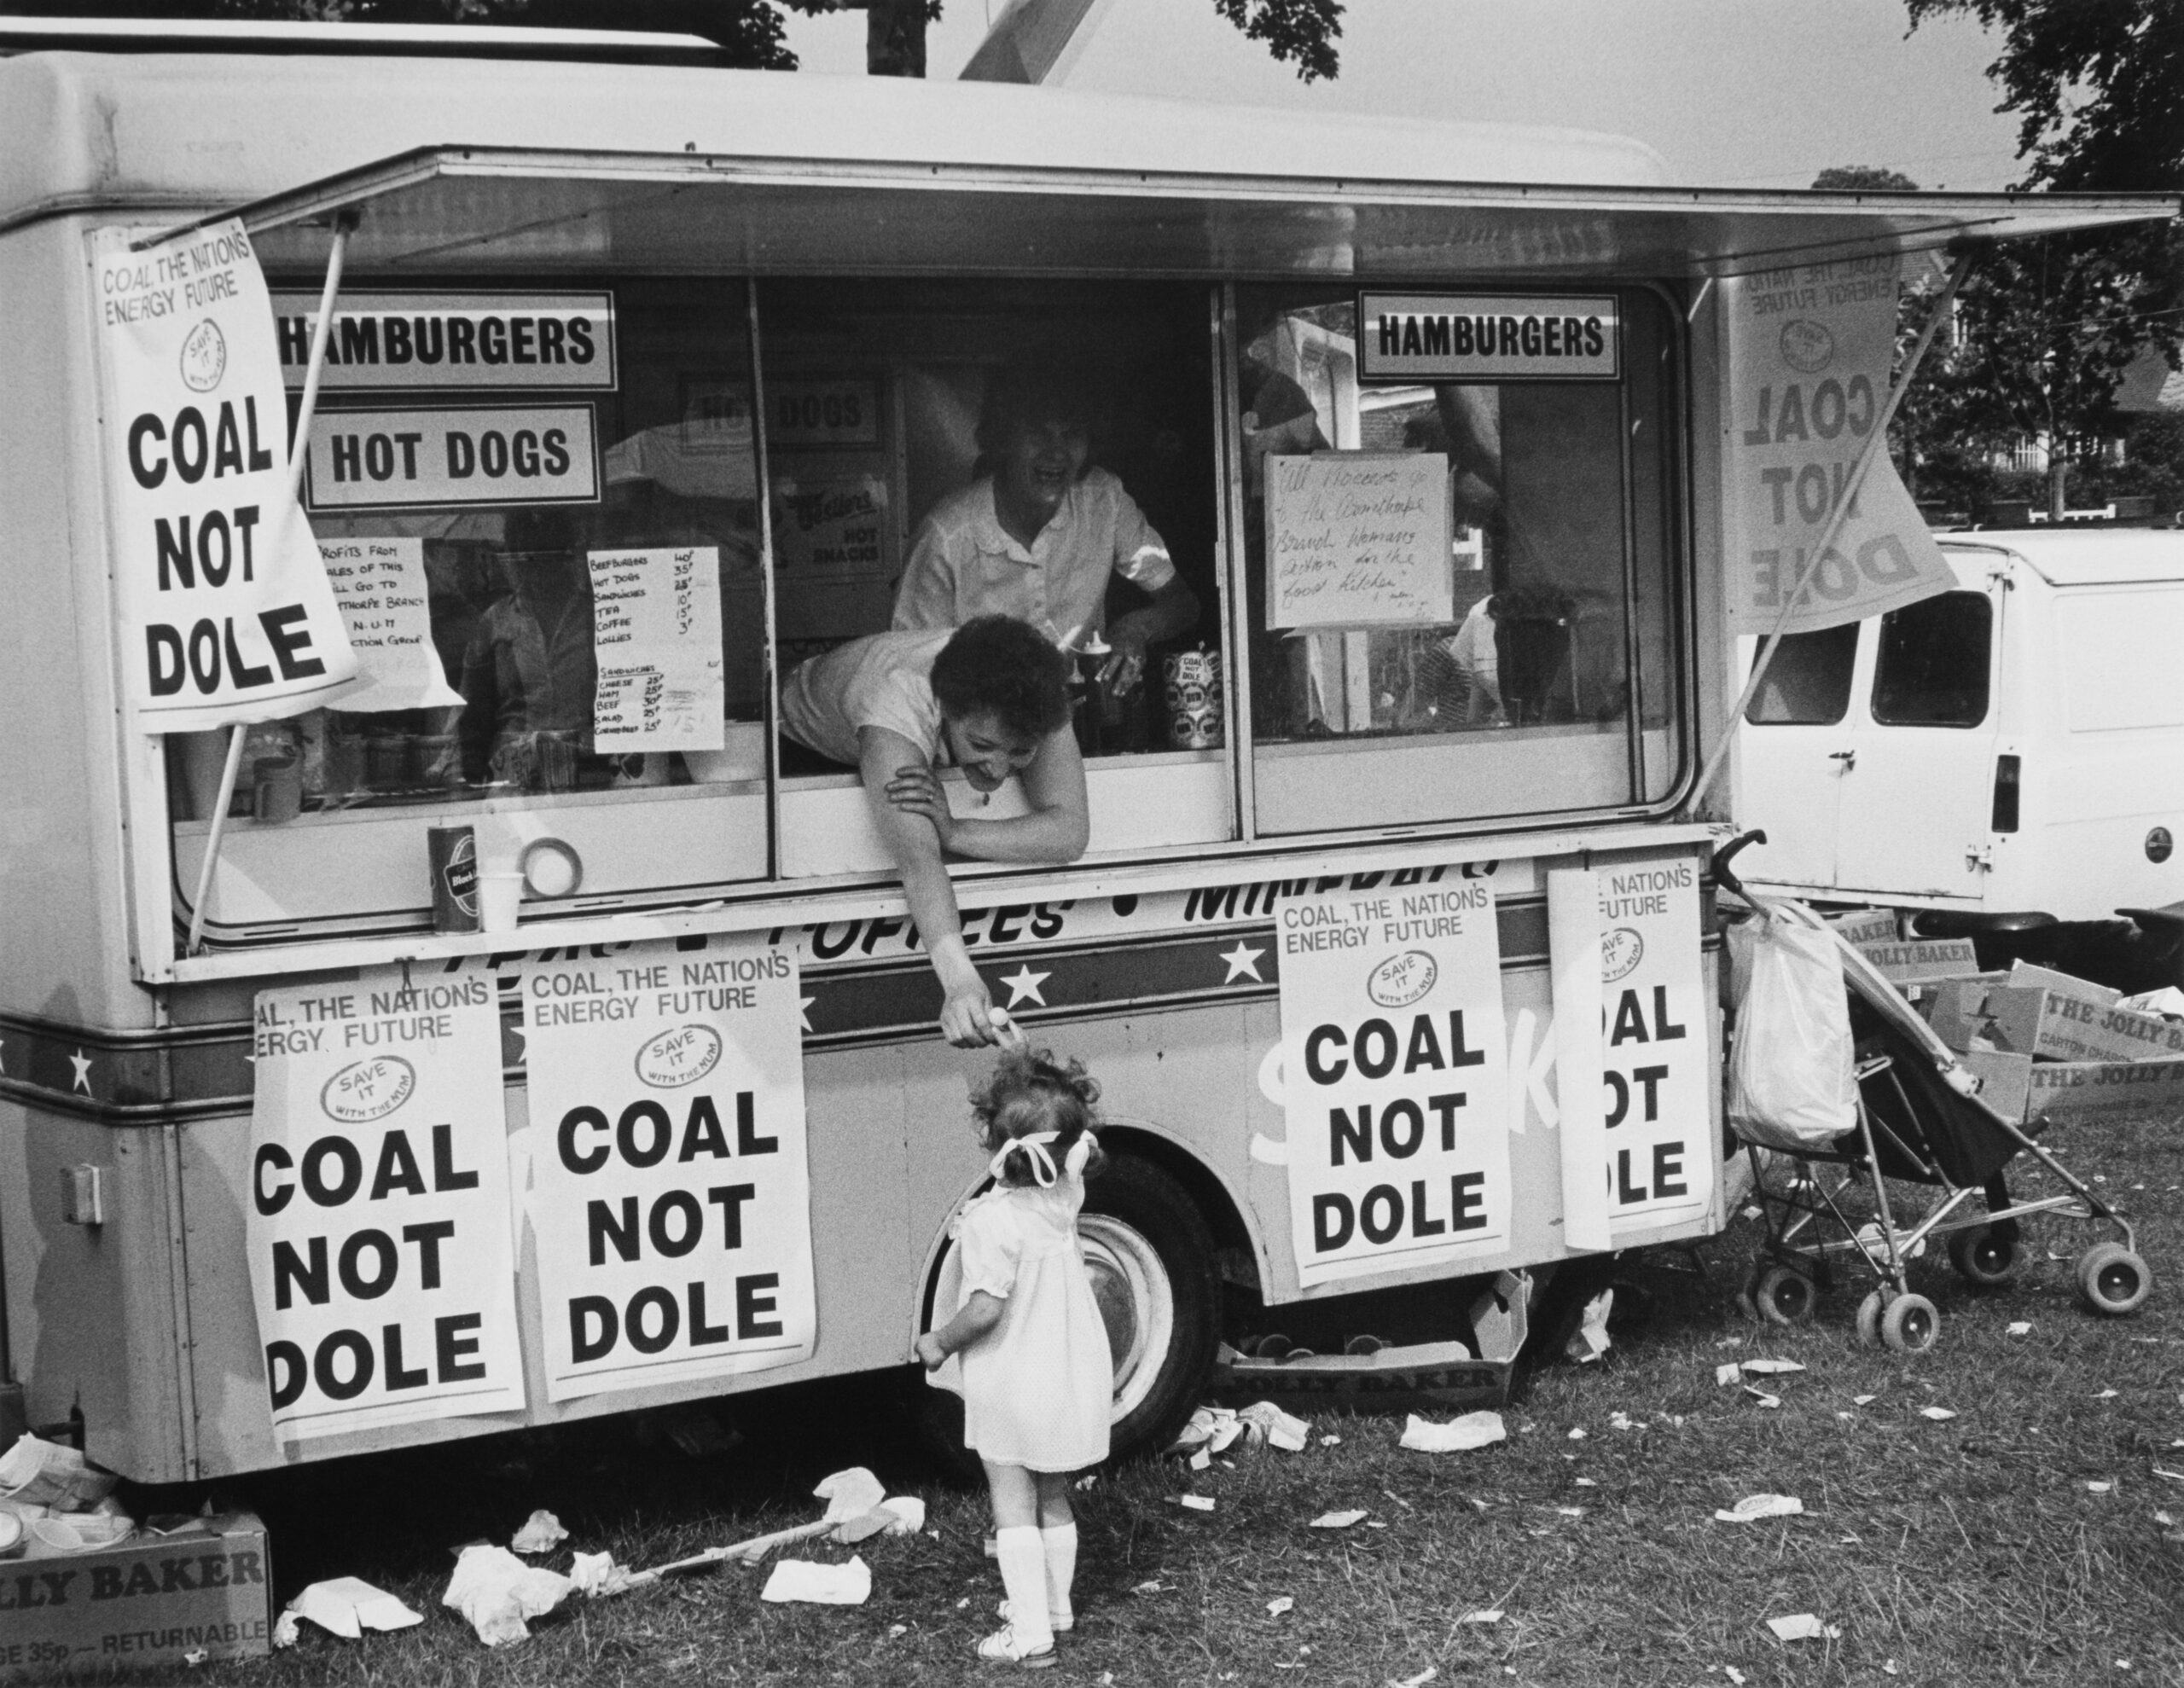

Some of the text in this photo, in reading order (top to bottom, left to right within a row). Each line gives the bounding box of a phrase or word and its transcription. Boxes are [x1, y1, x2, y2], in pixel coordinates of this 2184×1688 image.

[157, 251, 189, 283] THE
[189, 224, 251, 273] NATION'S
[105, 270, 239, 327] ENERGY FUTURE
[1378, 314, 1605, 357] HAMBURGERS
[778, 393, 862, 427] DOGS
[128, 395, 273, 490] COAL
[331, 427, 571, 483] HOT DOGS
[155, 504, 260, 592] NOT
[369, 546, 398, 556] FROM
[812, 546, 879, 563] SNACKS
[845, 527, 878, 544] HOT
[359, 563, 375, 573] OF
[593, 578, 609, 589] HOT
[613, 573, 641, 585] DOGS
[338, 598, 380, 611] THORPE
[596, 606, 620, 618] TEA
[596, 618, 632, 632] COFFEE
[146, 602, 328, 697] DOLE
[1183, 658, 1202, 666] COAL
[599, 679, 634, 690] CHEESE
[599, 690, 620, 699] HAM
[1182, 672, 1201, 681] DOLE
[594, 714, 624, 724] SALAD
[596, 700, 620, 711] BEEF
[1612, 862, 1693, 895] NATION'S
[1284, 901, 1350, 931] COAL,
[1350, 898, 1392, 923] THE
[1402, 882, 1489, 918] NATION'S
[1286, 917, 1463, 954] ENERGY FUTURE
[1917, 944, 1974, 963] BAKER
[532, 971, 615, 1000] COAL,
[616, 965, 670, 992] THE
[682, 948, 792, 987] NATION'S
[1381, 955, 1416, 981] SAVE
[1396, 974, 1408, 989] IT
[299, 995, 357, 1024] THE
[369, 975, 490, 1017] NATION'S
[535, 986, 758, 1028] ENERGY FUTURE
[1601, 984, 1687, 1047] AL
[2048, 993, 2094, 1024] THE
[2100, 1011, 2165, 1044] JOLLY
[344, 1014, 453, 1048] FUTURE
[653, 1030, 696, 1059] SAVE
[1304, 1009, 1485, 1087] COAL
[2039, 1031, 2087, 1055] CARTON
[340, 1062, 387, 1093] SAVE
[648, 1042, 717, 1083] WITH THE NUM
[670, 1051, 685, 1067] IT
[2029, 1068, 2087, 1089] THE
[2094, 1064, 2167, 1088] JOLLY
[335, 1074, 410, 1117] WITH THE NUM
[358, 1084, 375, 1101] IT
[558, 1091, 779, 1175] COAL
[1329, 1092, 1467, 1168] NOT
[253, 1124, 479, 1216] COAL
[1606, 1140, 1688, 1206] LE
[586, 1182, 755, 1267] NOT
[1312, 1170, 1488, 1254] DOLE
[271, 1220, 456, 1312] NOT
[569, 1272, 783, 1365] DOLE
[264, 1312, 486, 1412] DOLE
[90, 1551, 264, 1601] BAKER
[28, 1641, 69, 1664] 35p
[102, 1621, 266, 1655] RETURNABLE
